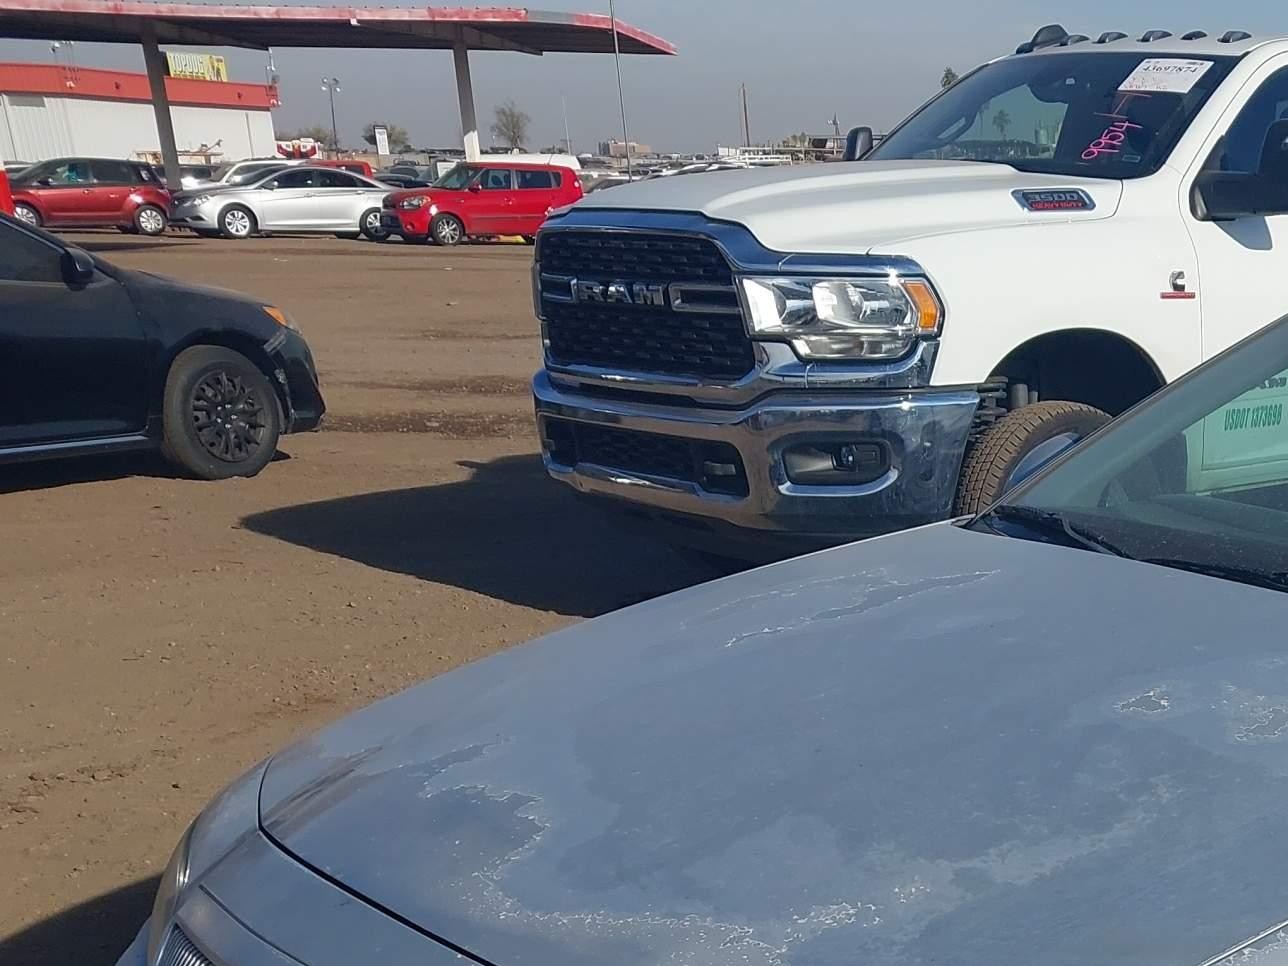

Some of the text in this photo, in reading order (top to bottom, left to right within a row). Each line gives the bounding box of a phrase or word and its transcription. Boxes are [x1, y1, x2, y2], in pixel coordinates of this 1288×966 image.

[1028, 192, 1079, 201] 3500
[578, 280, 664, 305] RAM
[1224, 407, 1250, 431] USDOT
